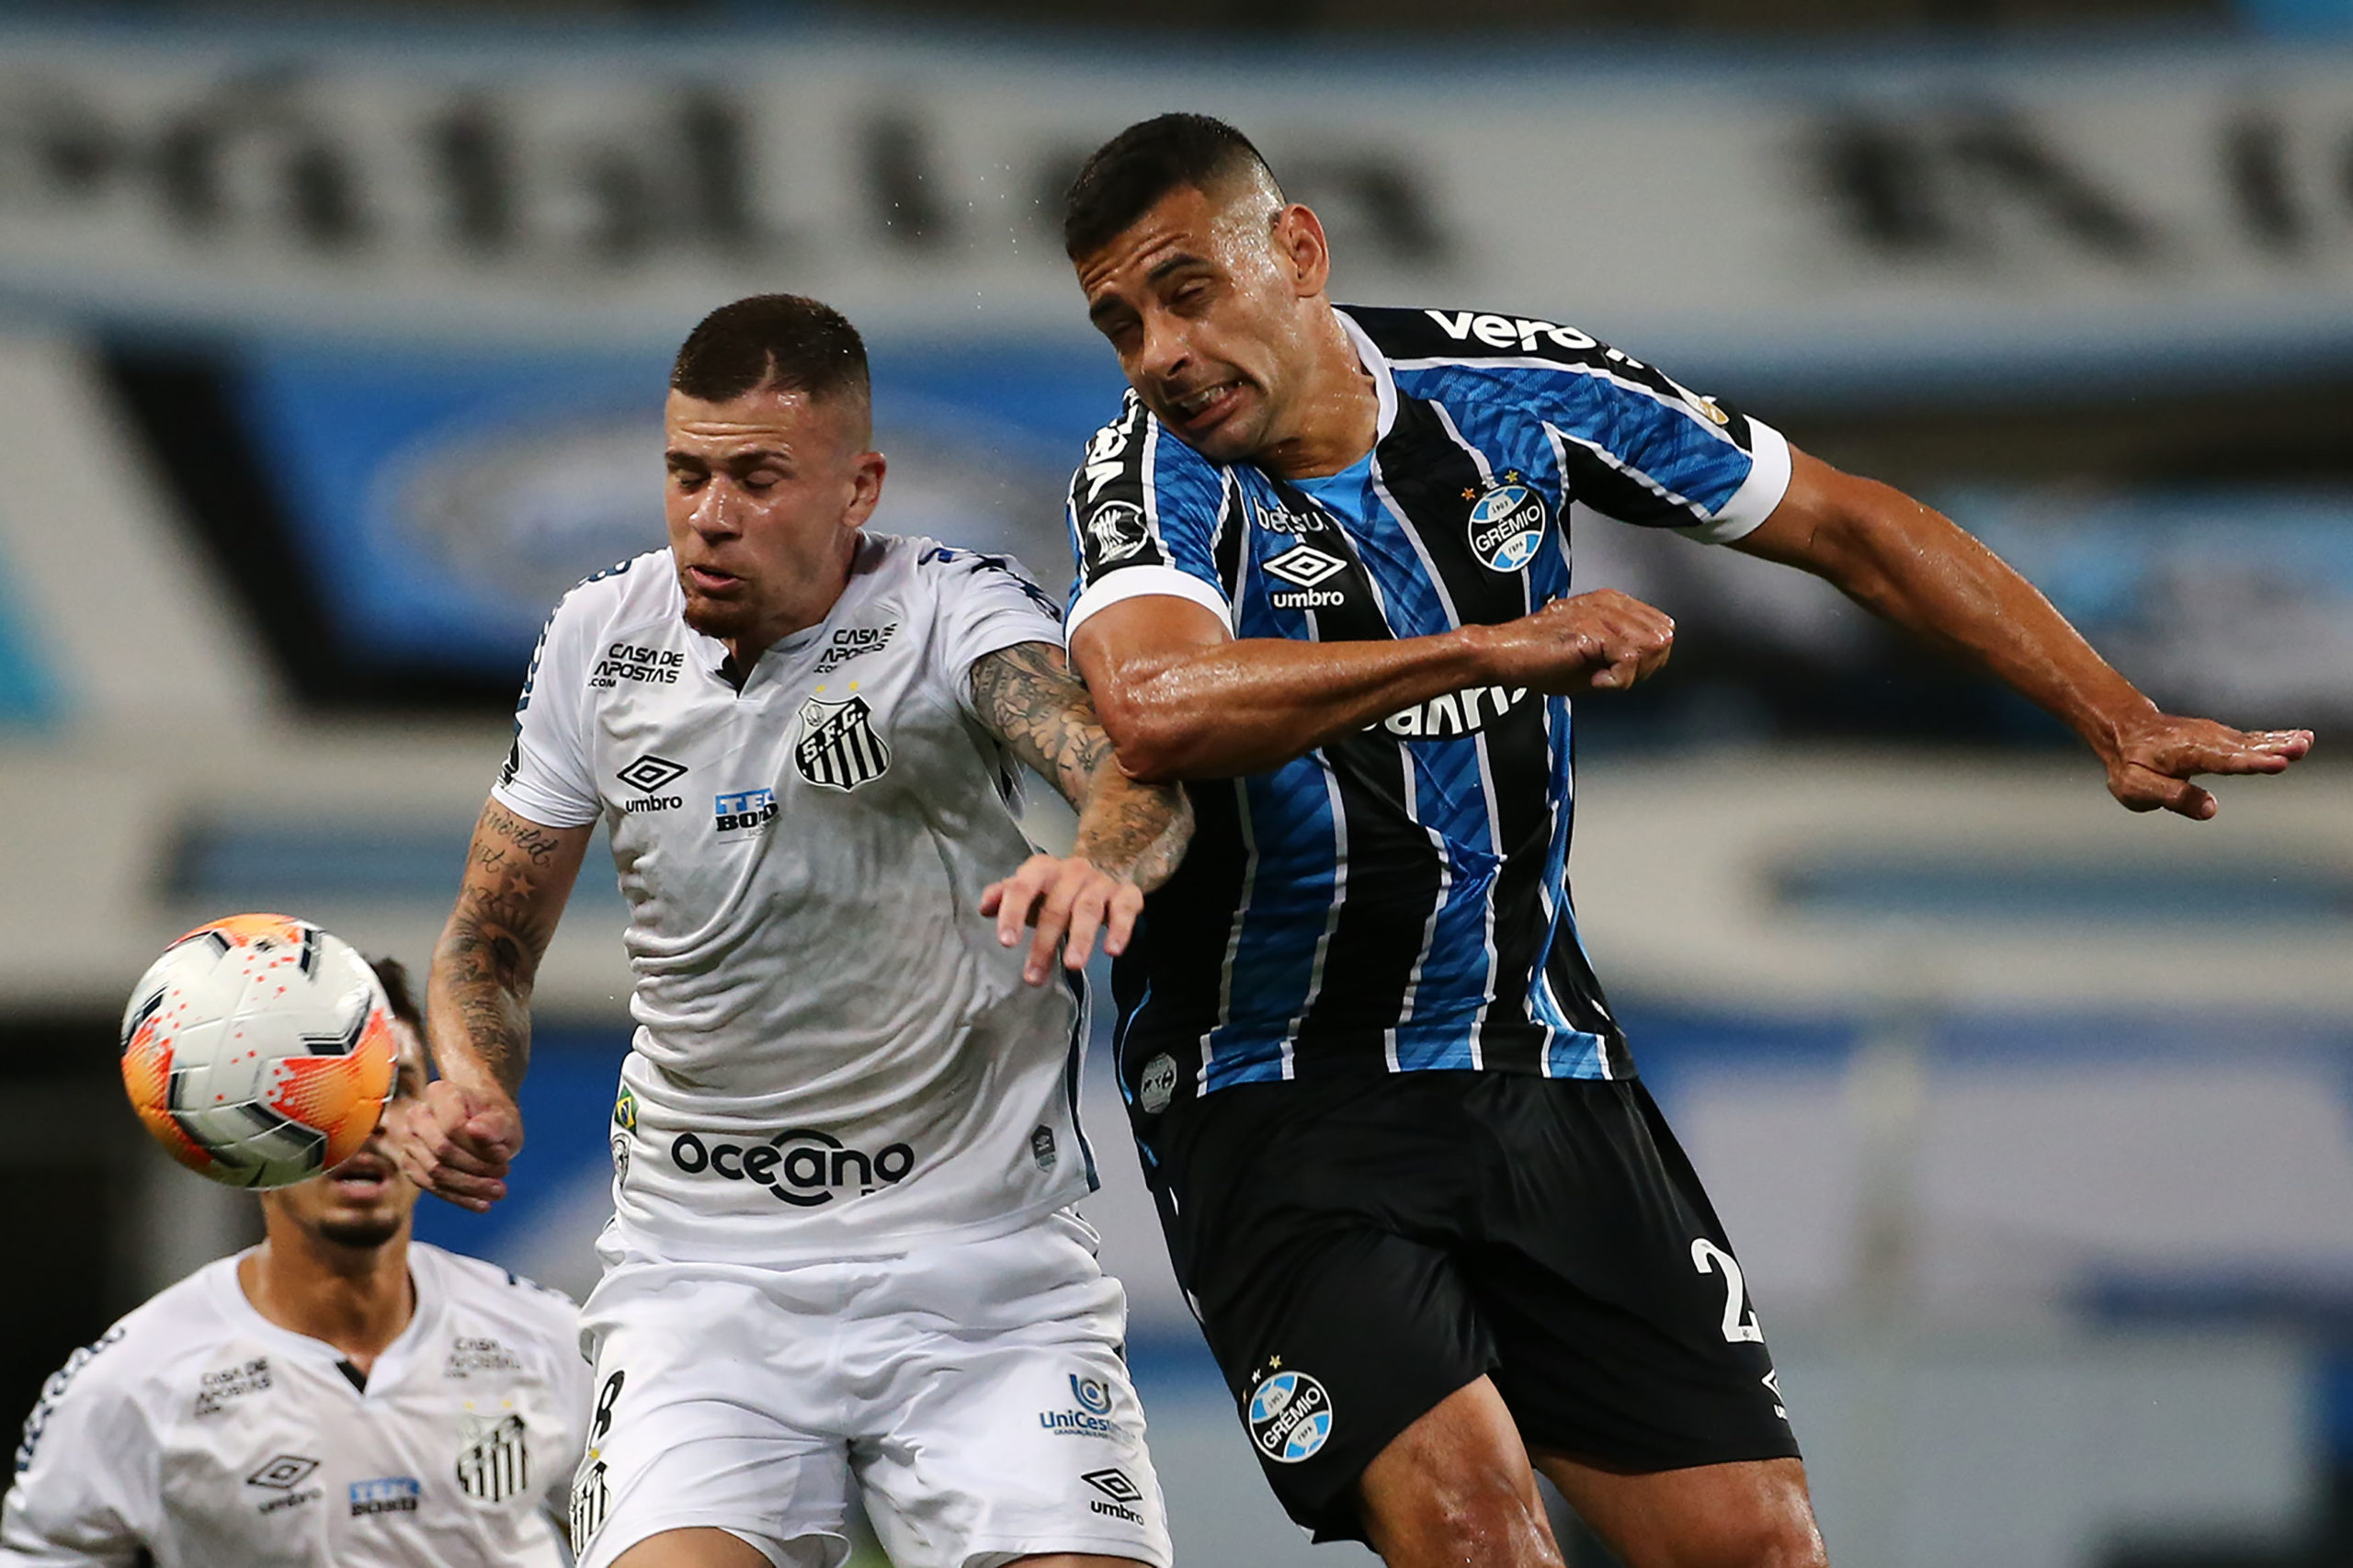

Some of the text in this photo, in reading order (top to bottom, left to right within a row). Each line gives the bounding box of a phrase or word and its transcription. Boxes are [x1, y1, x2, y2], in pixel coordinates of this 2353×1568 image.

[1474, 505, 1540, 552] GRÊMIO
[1273, 588, 1345, 608] umbro
[833, 629, 879, 645] CASA
[608, 642, 685, 667] CASA DE
[587, 678, 617, 688] .COM
[593, 661, 680, 684] APOSTAS
[625, 795, 683, 812] umbro
[671, 1132, 915, 1187] oceano
[1090, 1500, 1144, 1526] umbro
